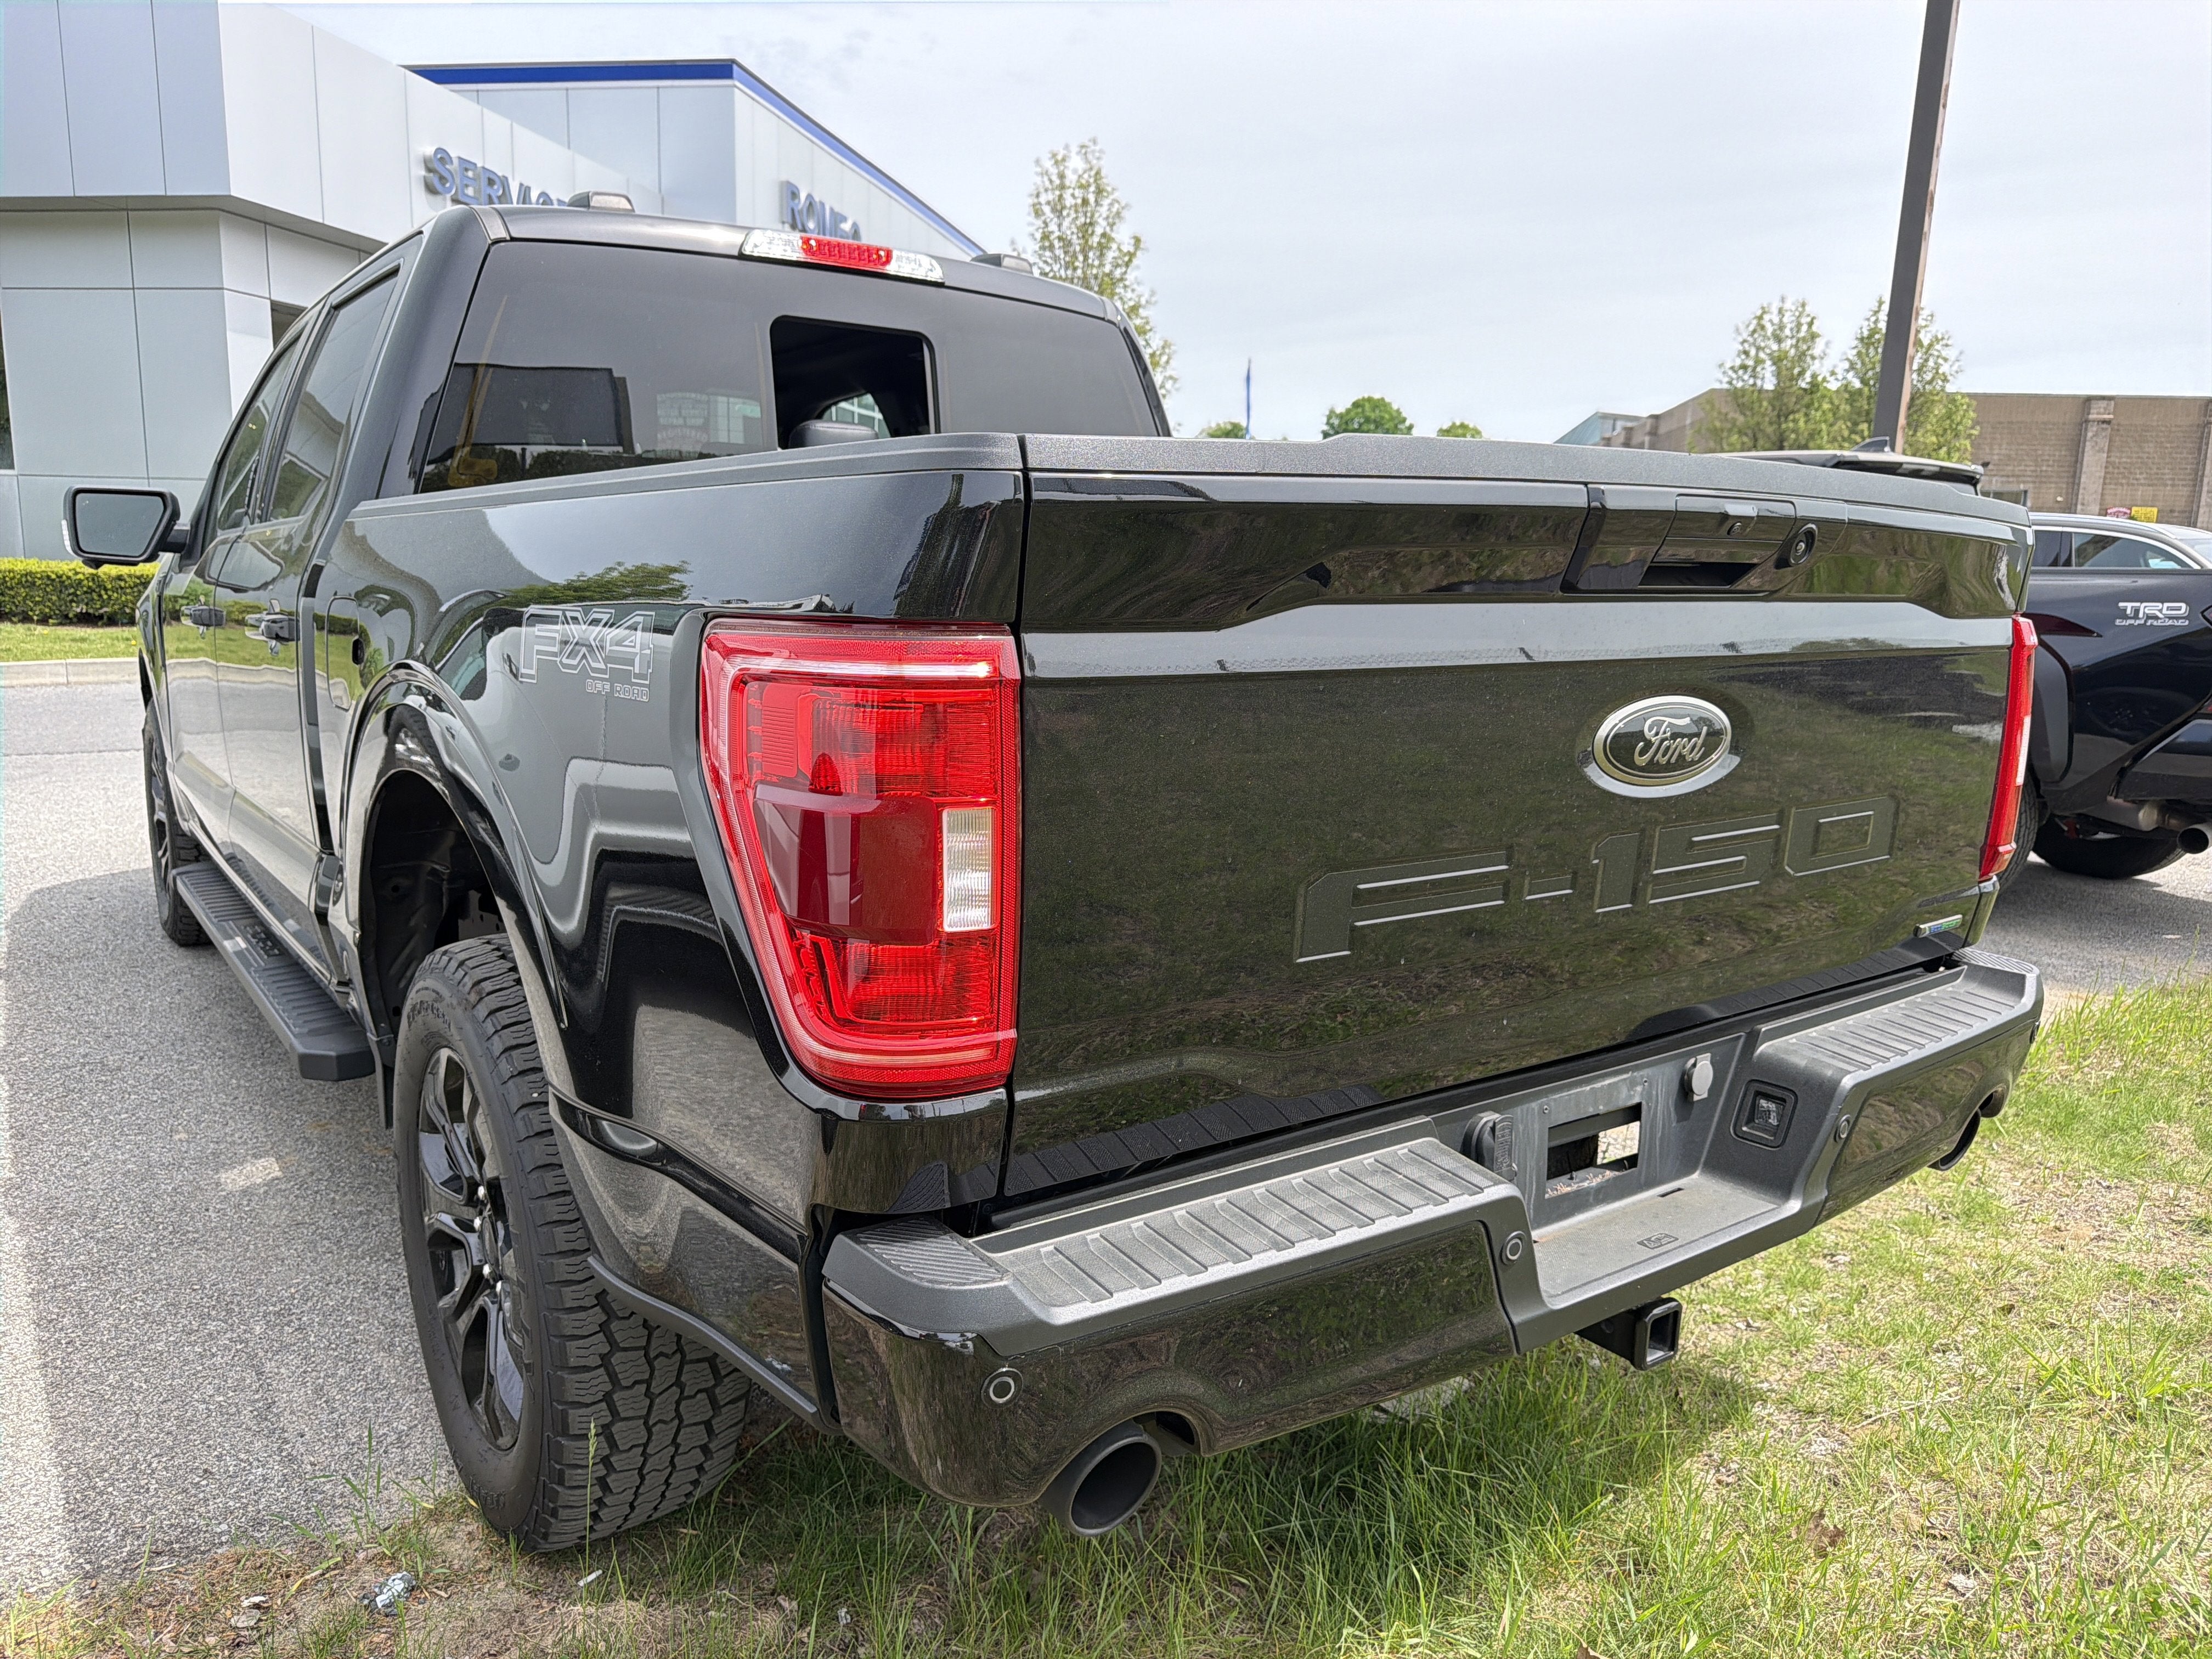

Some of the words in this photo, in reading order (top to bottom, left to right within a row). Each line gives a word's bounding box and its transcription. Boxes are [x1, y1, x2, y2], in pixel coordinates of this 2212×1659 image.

[425, 147, 568, 206] SERV
[2118, 602, 2190, 618] TRD
[2146, 618, 2190, 626] ROAD
[519, 605, 656, 684] FX4
[586, 679, 611, 695] OFF
[614, 683, 650, 702] ROAD
[1634, 716, 1708, 766] Ford
[1295, 795, 1899, 963] F-150
